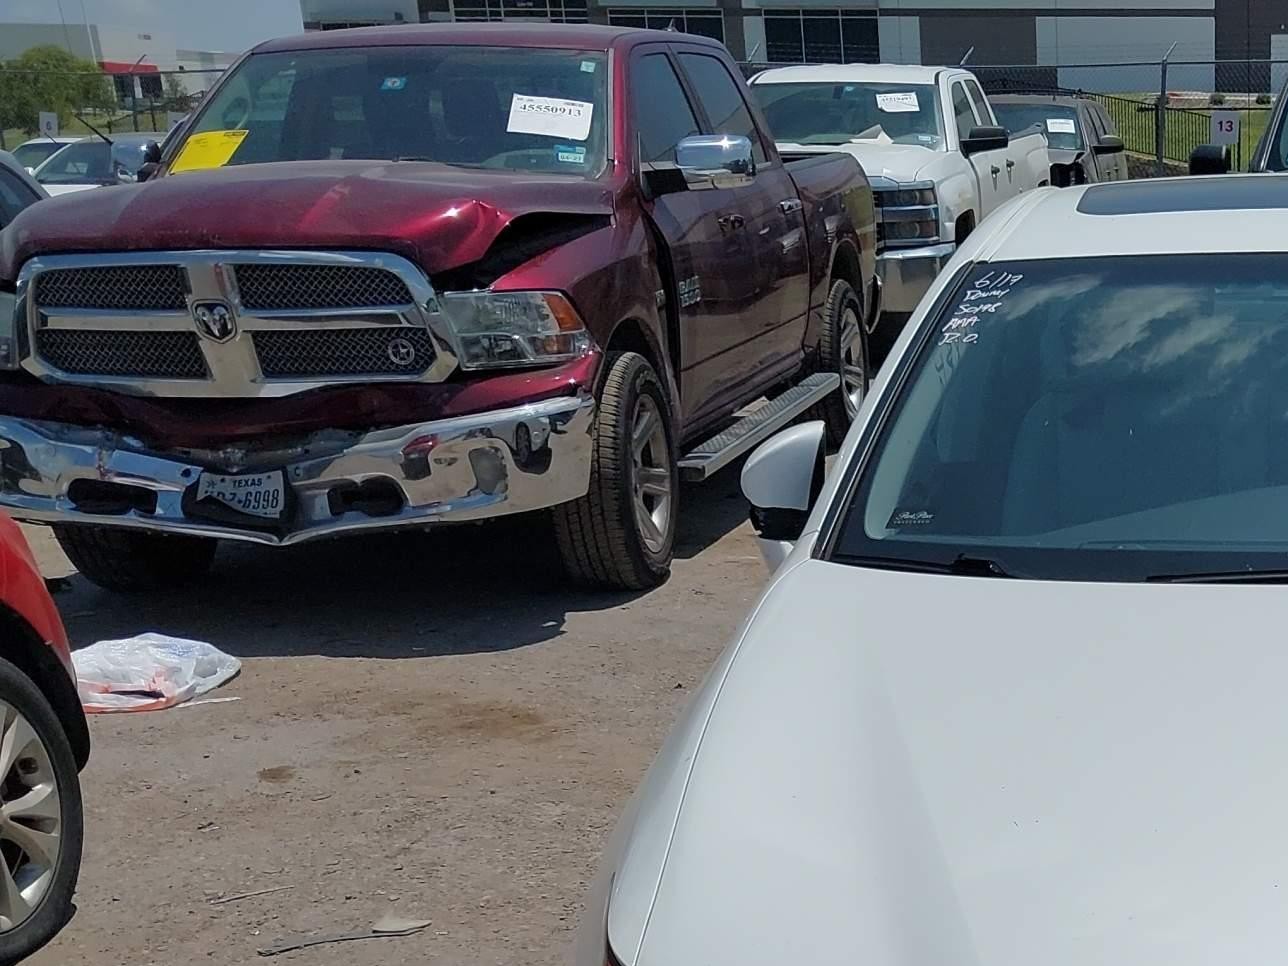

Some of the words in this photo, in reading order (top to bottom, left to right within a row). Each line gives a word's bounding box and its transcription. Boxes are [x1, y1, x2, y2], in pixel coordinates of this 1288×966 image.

[519, 103, 583, 118] 45550913
[1217, 120, 1233, 132] 13
[232, 478, 263, 489] TEXAS
